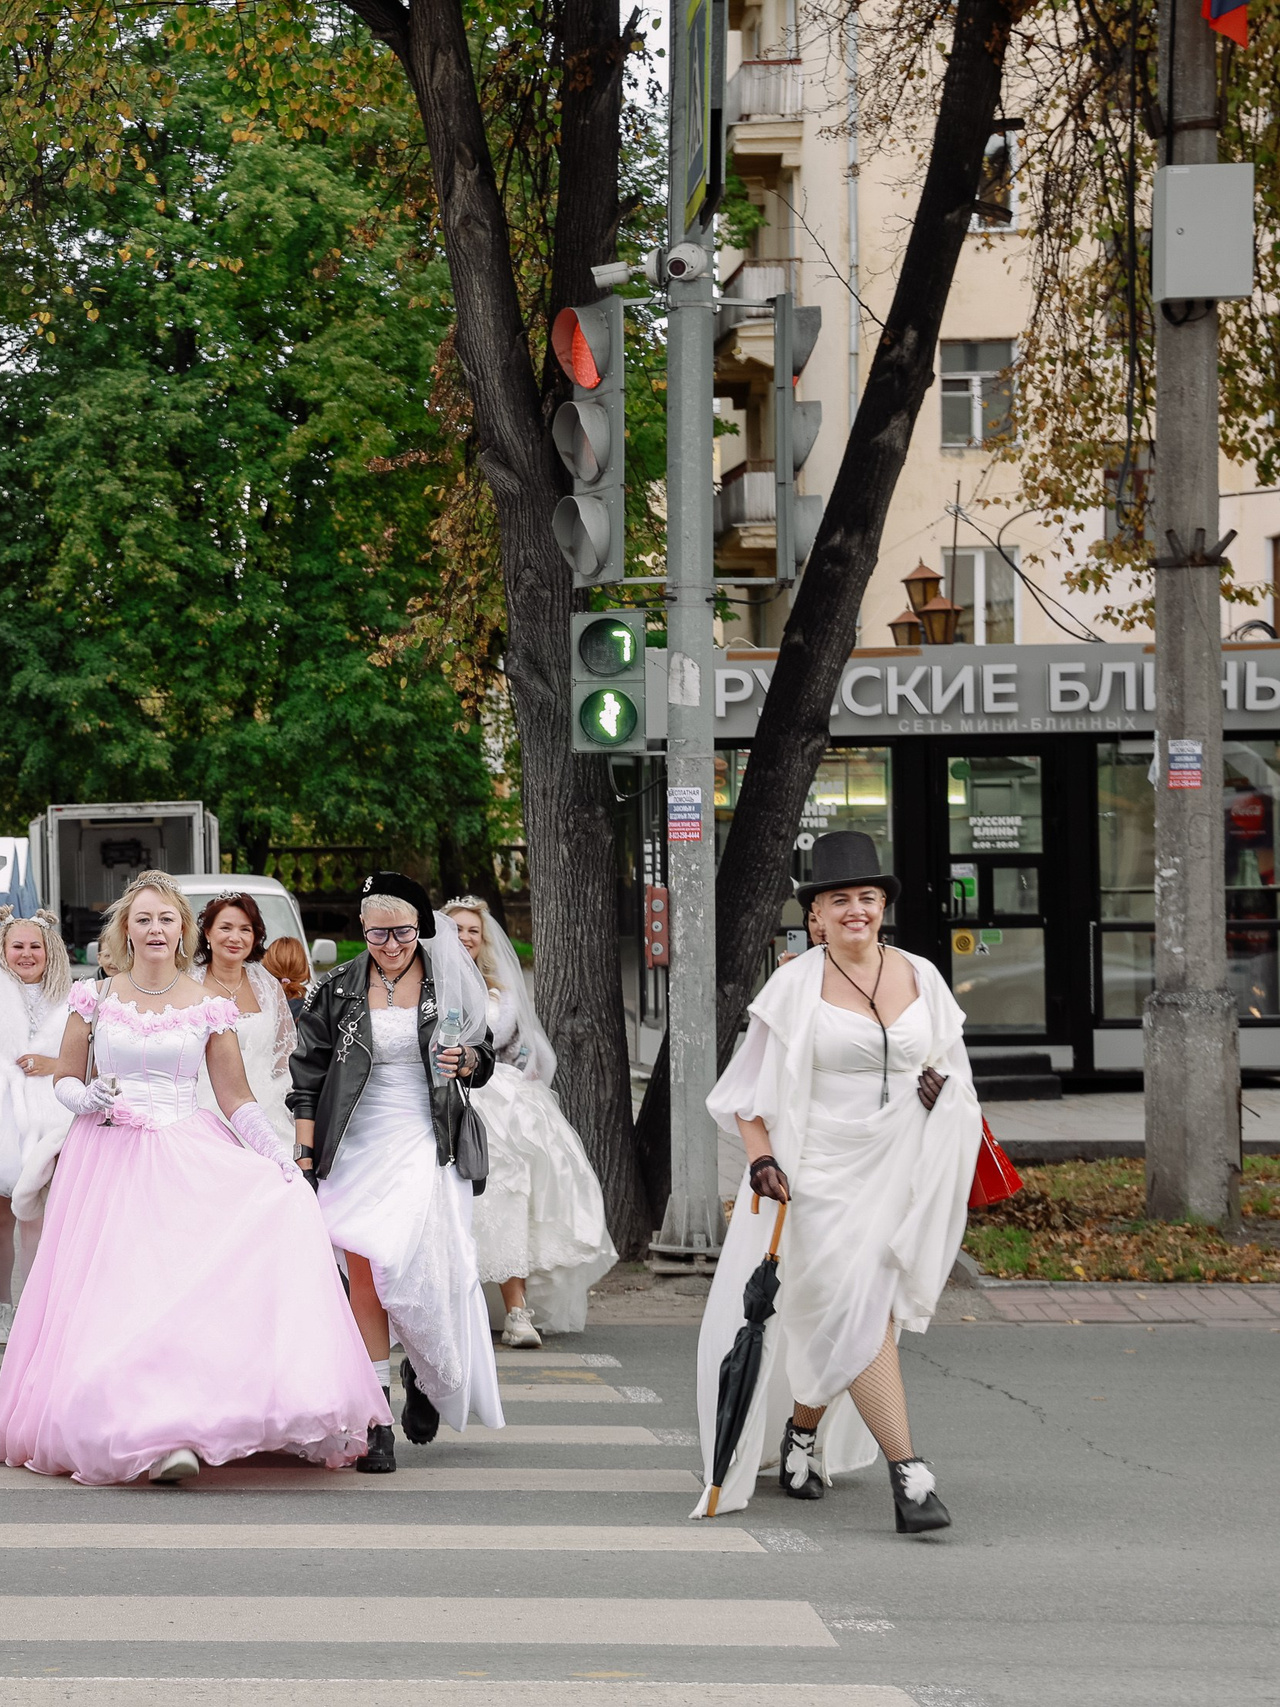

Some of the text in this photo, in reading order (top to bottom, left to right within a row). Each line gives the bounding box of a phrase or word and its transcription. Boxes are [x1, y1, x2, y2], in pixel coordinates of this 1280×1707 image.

[612, 630, 632, 662] 7
[714, 661, 1280, 718] РСКИЕ БЛЫ
[898, 716, 1137, 733] СЕТЬ МИНИ-БЛИННЫХ
[968, 815, 1022, 826] РУССКИЕ
[973, 826, 1018, 837] БЛИНЫ
